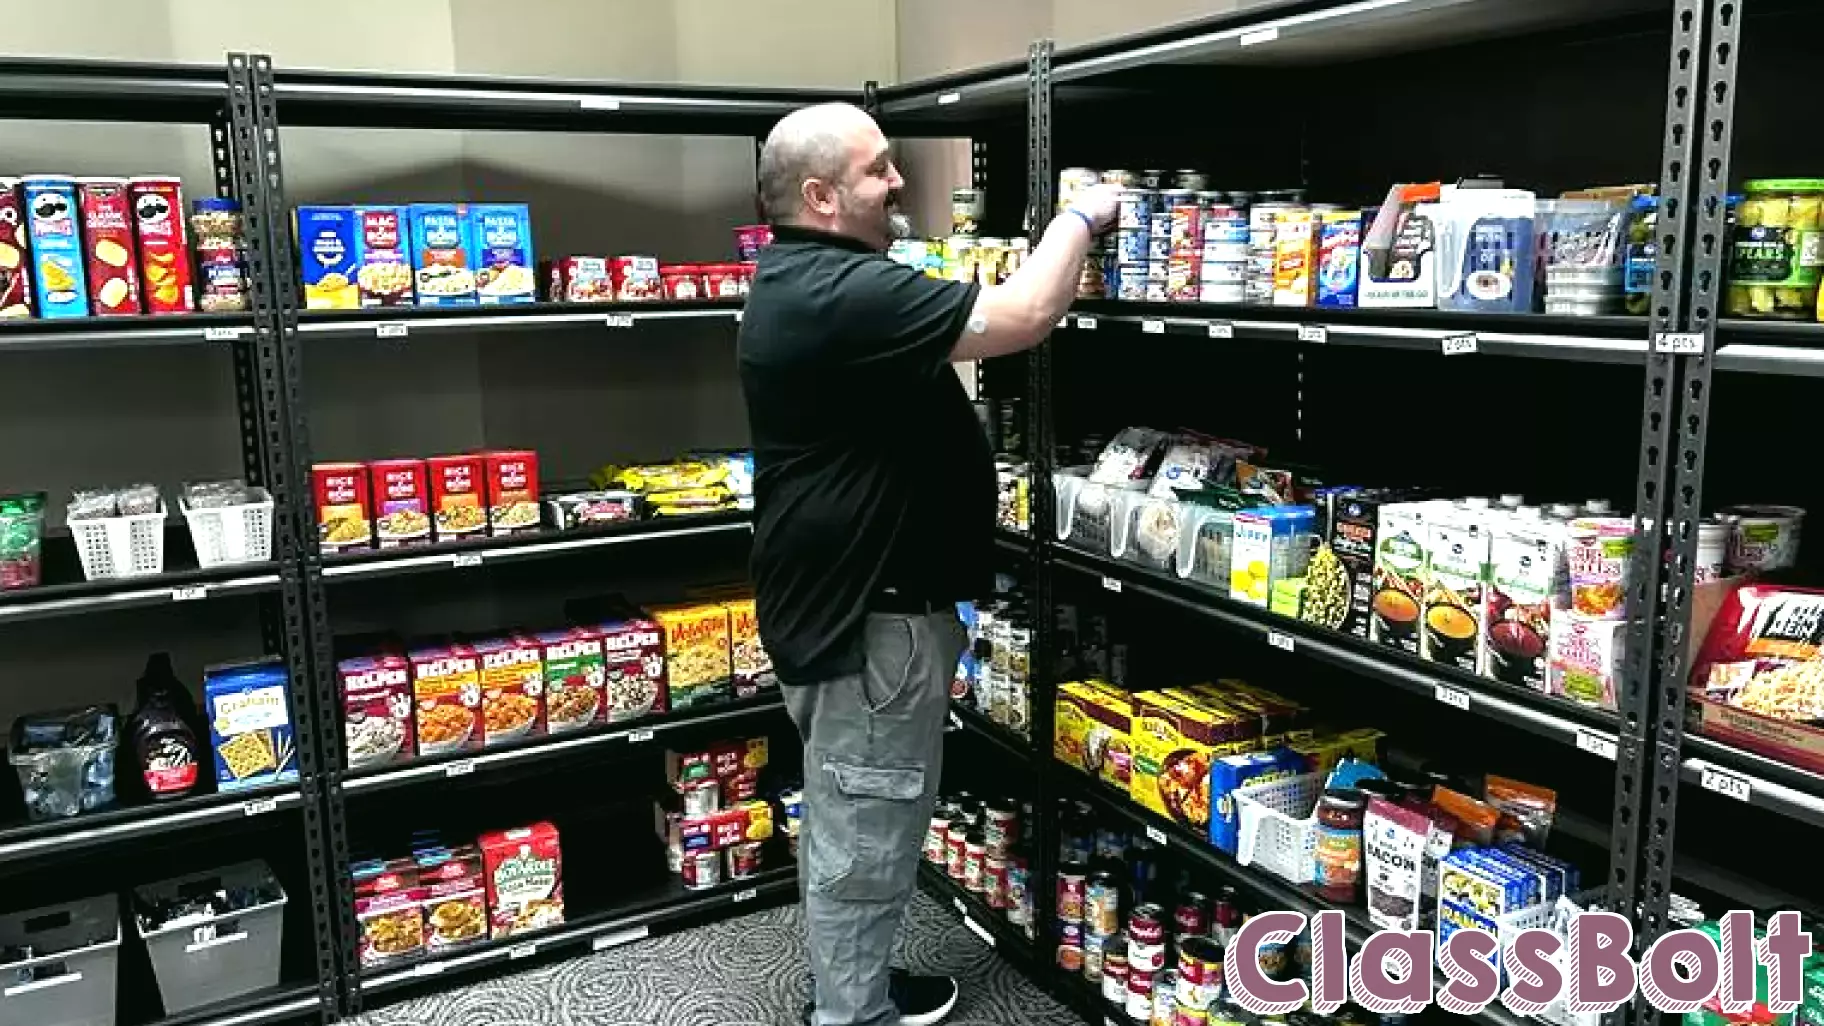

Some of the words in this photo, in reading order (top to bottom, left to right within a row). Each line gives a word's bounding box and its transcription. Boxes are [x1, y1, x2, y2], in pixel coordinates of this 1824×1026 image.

[546, 640, 601, 659] HELPER
[606, 632, 660, 650] HELPER
[482, 649, 540, 667] HELPER
[416, 658, 476, 678] HELPER
[344, 670, 407, 691] HELPER
[1367, 842, 1417, 874] BACON
